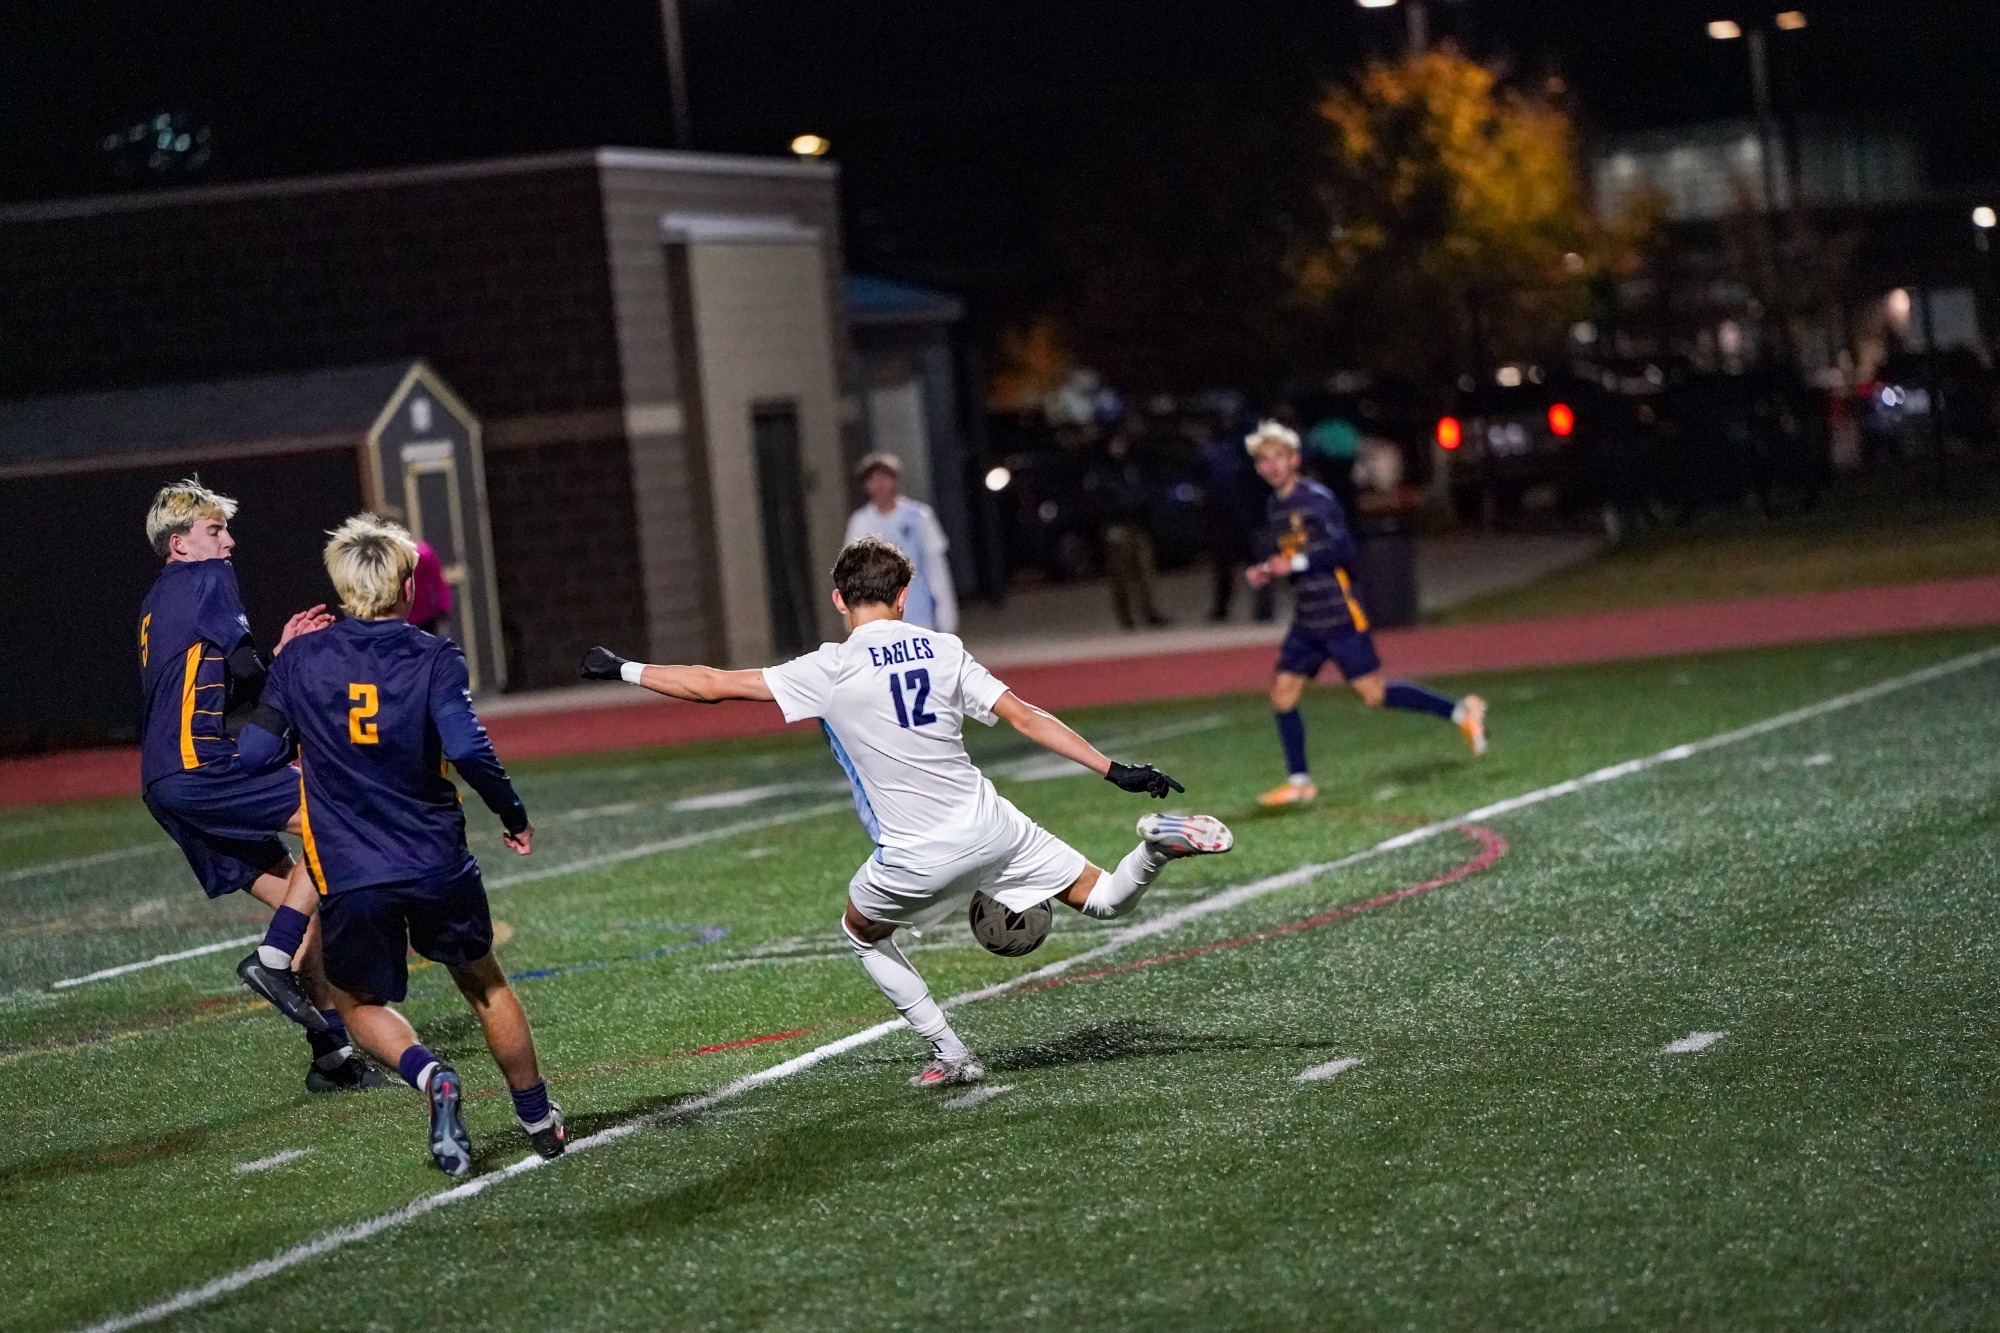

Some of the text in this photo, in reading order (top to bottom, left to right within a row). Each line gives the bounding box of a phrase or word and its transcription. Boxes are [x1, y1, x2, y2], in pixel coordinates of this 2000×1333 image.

[868, 637, 935, 667] EAGLES
[348, 682, 379, 745] 2
[889, 667, 937, 728] 12
